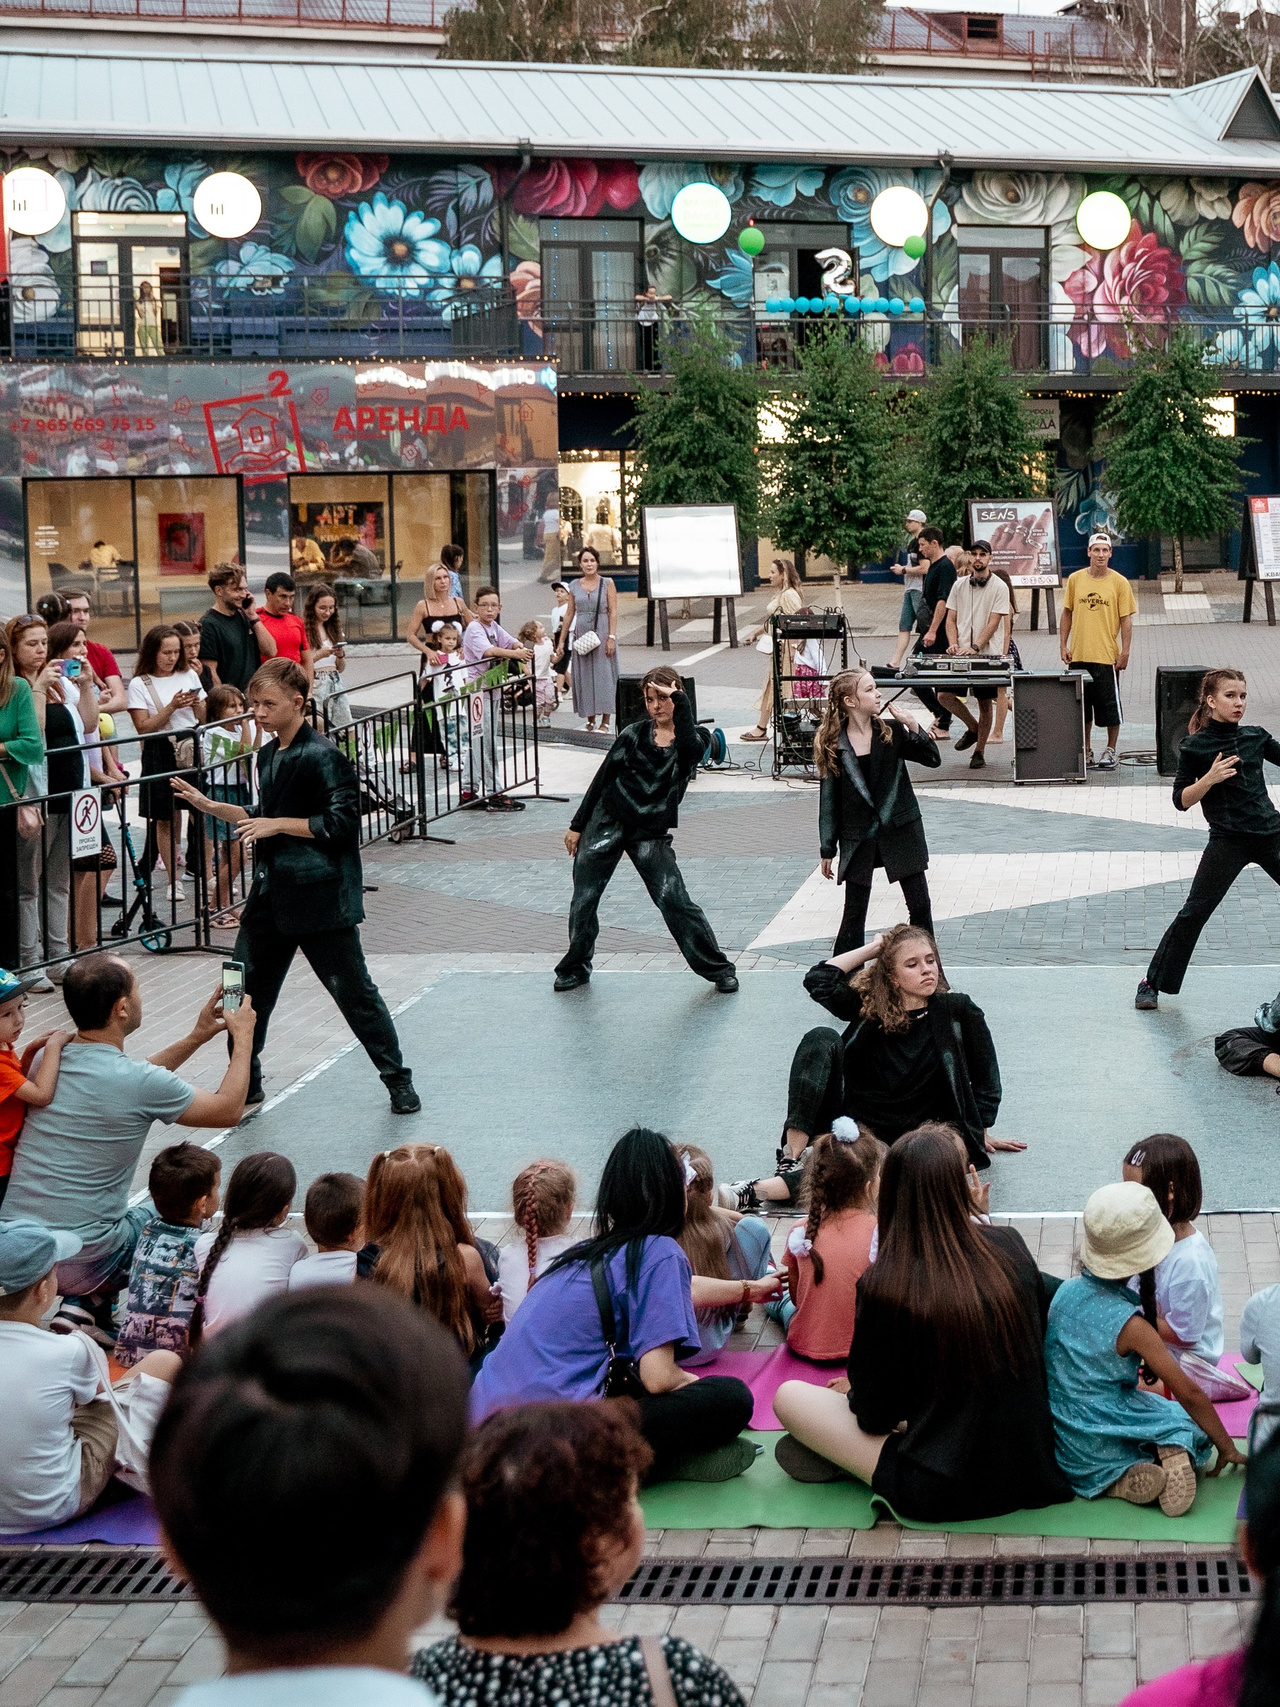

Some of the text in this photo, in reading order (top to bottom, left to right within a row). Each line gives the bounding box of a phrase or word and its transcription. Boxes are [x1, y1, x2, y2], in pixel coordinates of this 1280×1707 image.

[268, 370, 293, 397] 2
[10, 417, 156, 432] +7 965 669 75 15
[333, 405, 470, 435] АРЕНДА
[981, 508, 1016, 521] SENS
[1079, 599, 1109, 607] UNIVERSAL
